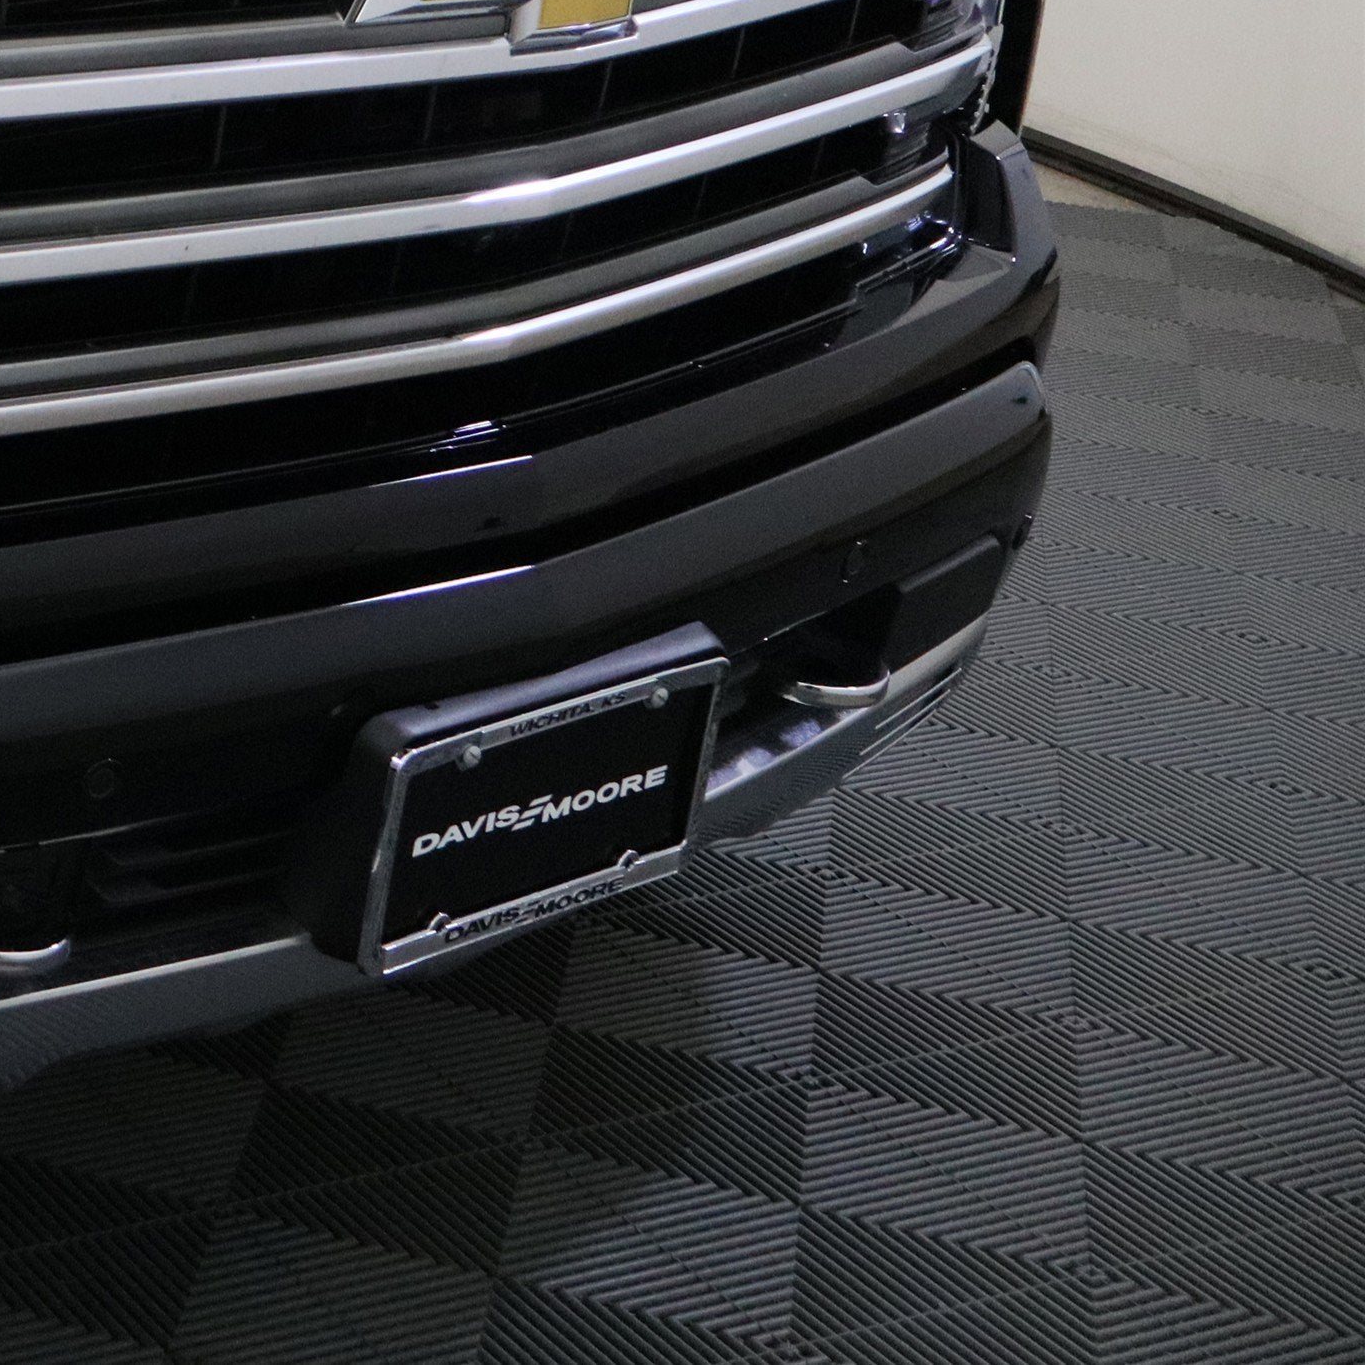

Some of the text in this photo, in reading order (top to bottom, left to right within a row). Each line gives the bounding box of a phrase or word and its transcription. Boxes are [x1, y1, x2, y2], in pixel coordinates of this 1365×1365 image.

[412, 765, 668, 858] DAVIS MOORE
[445, 878, 625, 943] DAVIS MOORE
